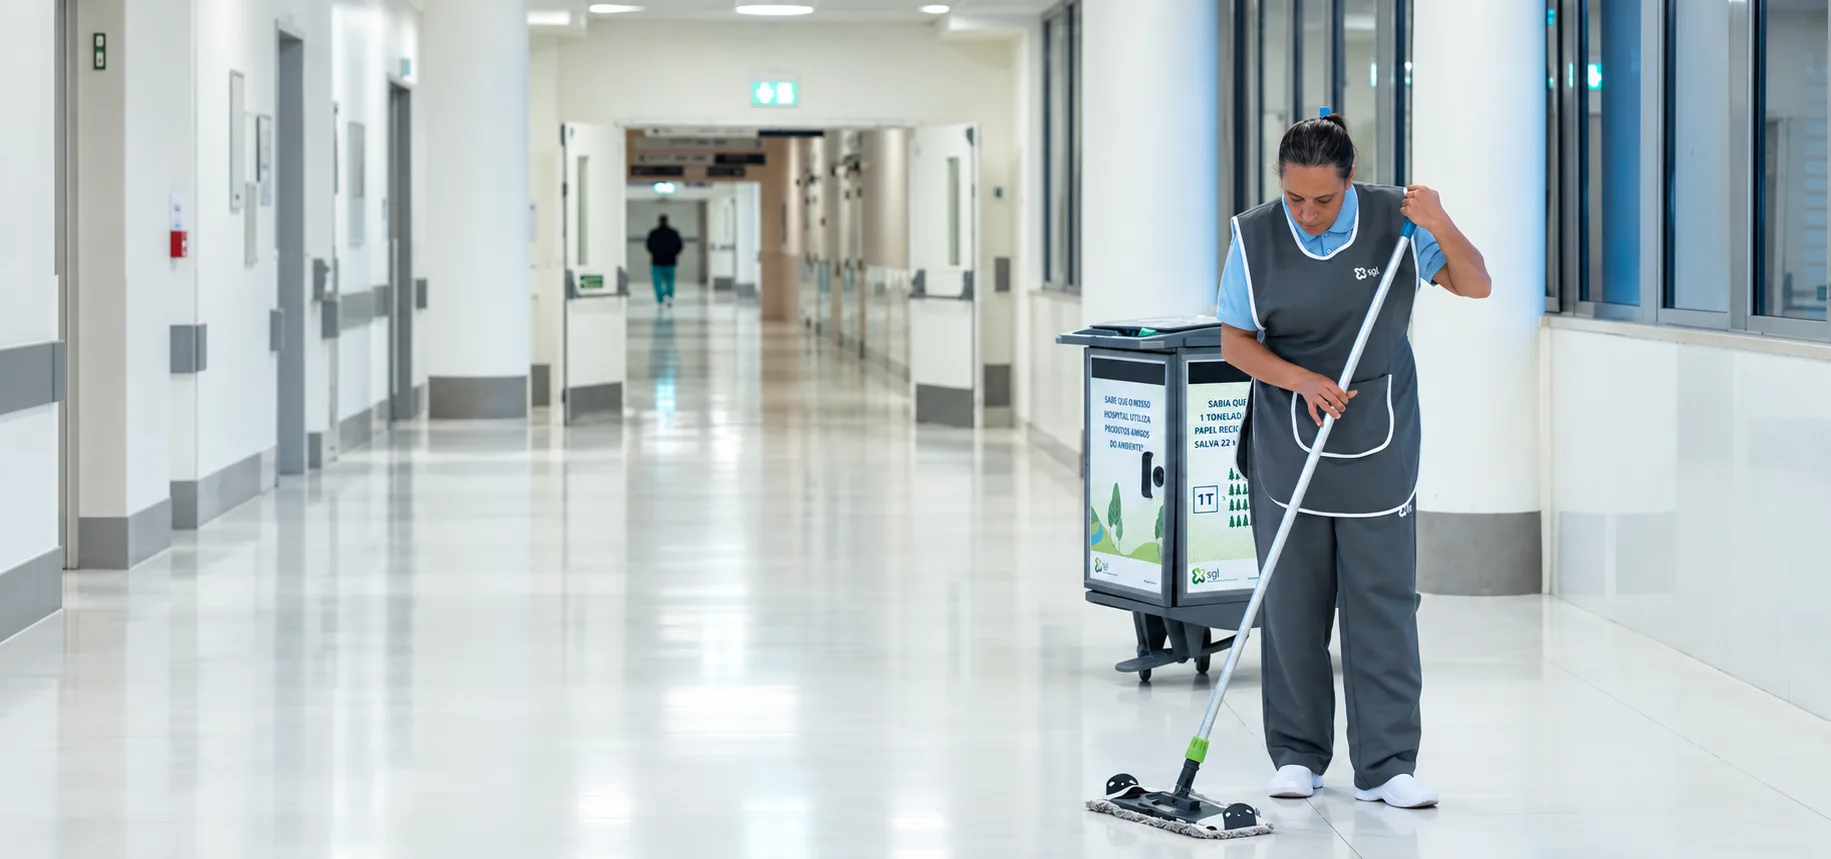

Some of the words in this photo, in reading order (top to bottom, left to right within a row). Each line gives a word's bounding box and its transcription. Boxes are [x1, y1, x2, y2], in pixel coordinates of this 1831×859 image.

[1104, 396, 1117, 404] SABE
[1117, 397, 1128, 406] QUE
[1133, 399, 1151, 408] NOSSO
[1208, 400, 1231, 408] SABIA
[1103, 410, 1129, 421] HOSPITAL
[1130, 413, 1151, 424] UTILIZA
[1206, 412, 1244, 421] TONELAD
[1130, 428, 1150, 439] AMIGOS
[1194, 426, 1217, 434] PAPEL
[1110, 440, 1117, 448] DO
[1194, 440, 1219, 448] SALVA
[1221, 439, 1231, 447] 22
[1198, 493, 1214, 506] 1T
[1206, 568, 1220, 580] sgl
